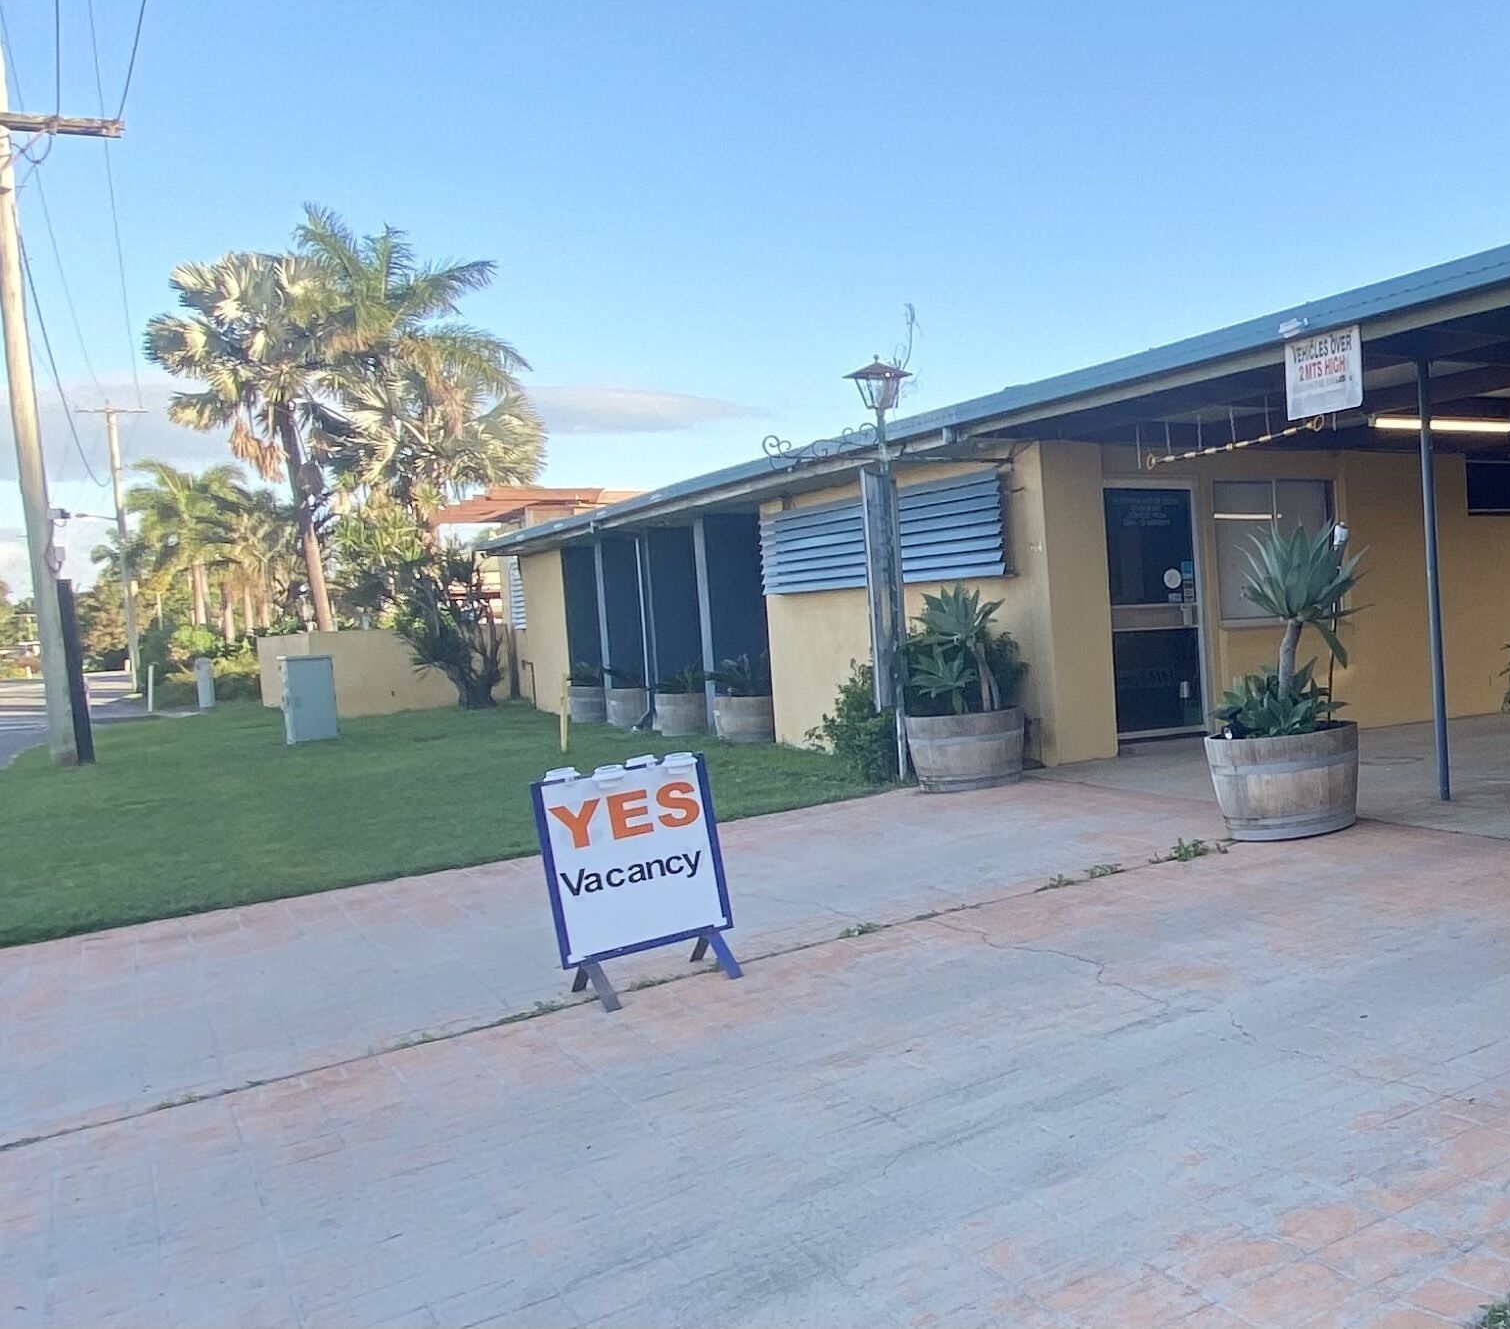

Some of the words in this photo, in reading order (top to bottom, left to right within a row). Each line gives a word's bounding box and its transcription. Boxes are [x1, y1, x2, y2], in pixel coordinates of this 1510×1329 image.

[1330, 334, 1352, 354] OVER
[1325, 355, 1345, 375] HIGH
[548, 781, 700, 849] YES
[560, 850, 701, 897] Vacancy
